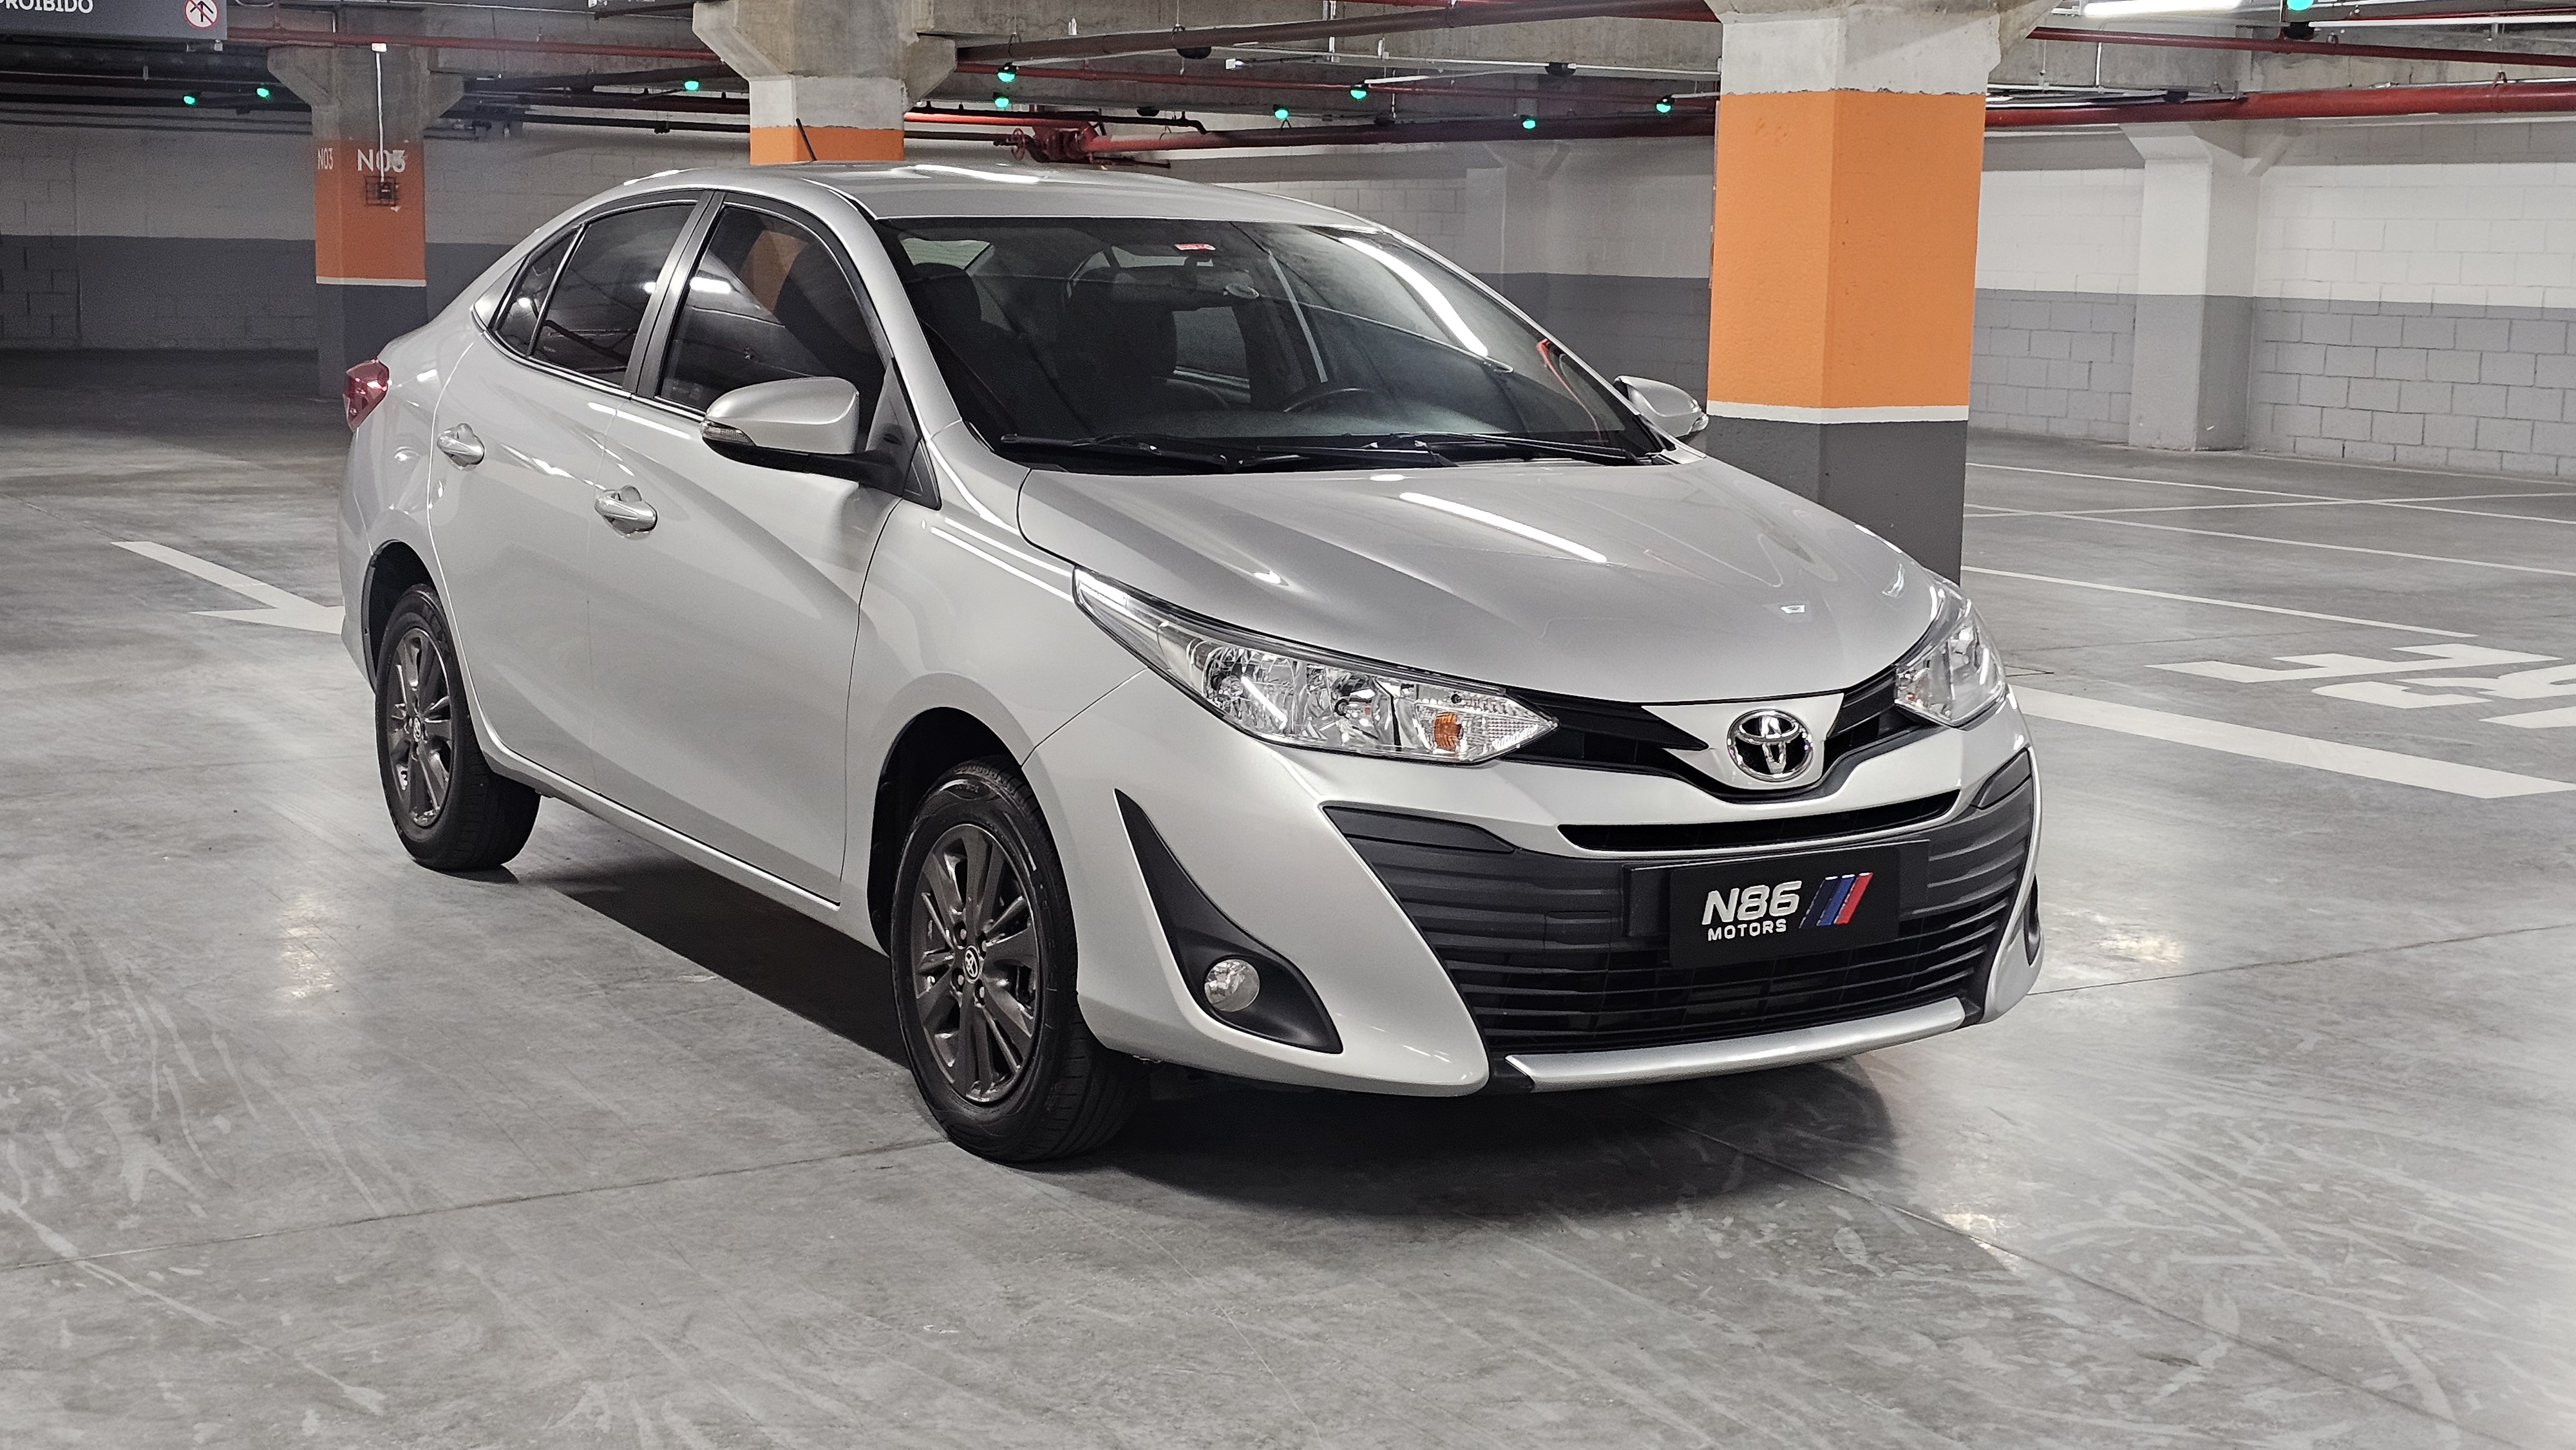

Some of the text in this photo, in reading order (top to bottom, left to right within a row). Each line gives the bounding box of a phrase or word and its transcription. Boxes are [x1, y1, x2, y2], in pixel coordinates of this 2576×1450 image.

[0, 0, 93, 13] ROIBIDO
[1701, 880, 1802, 925] N86
[1708, 919, 1786, 941] MOTORS
